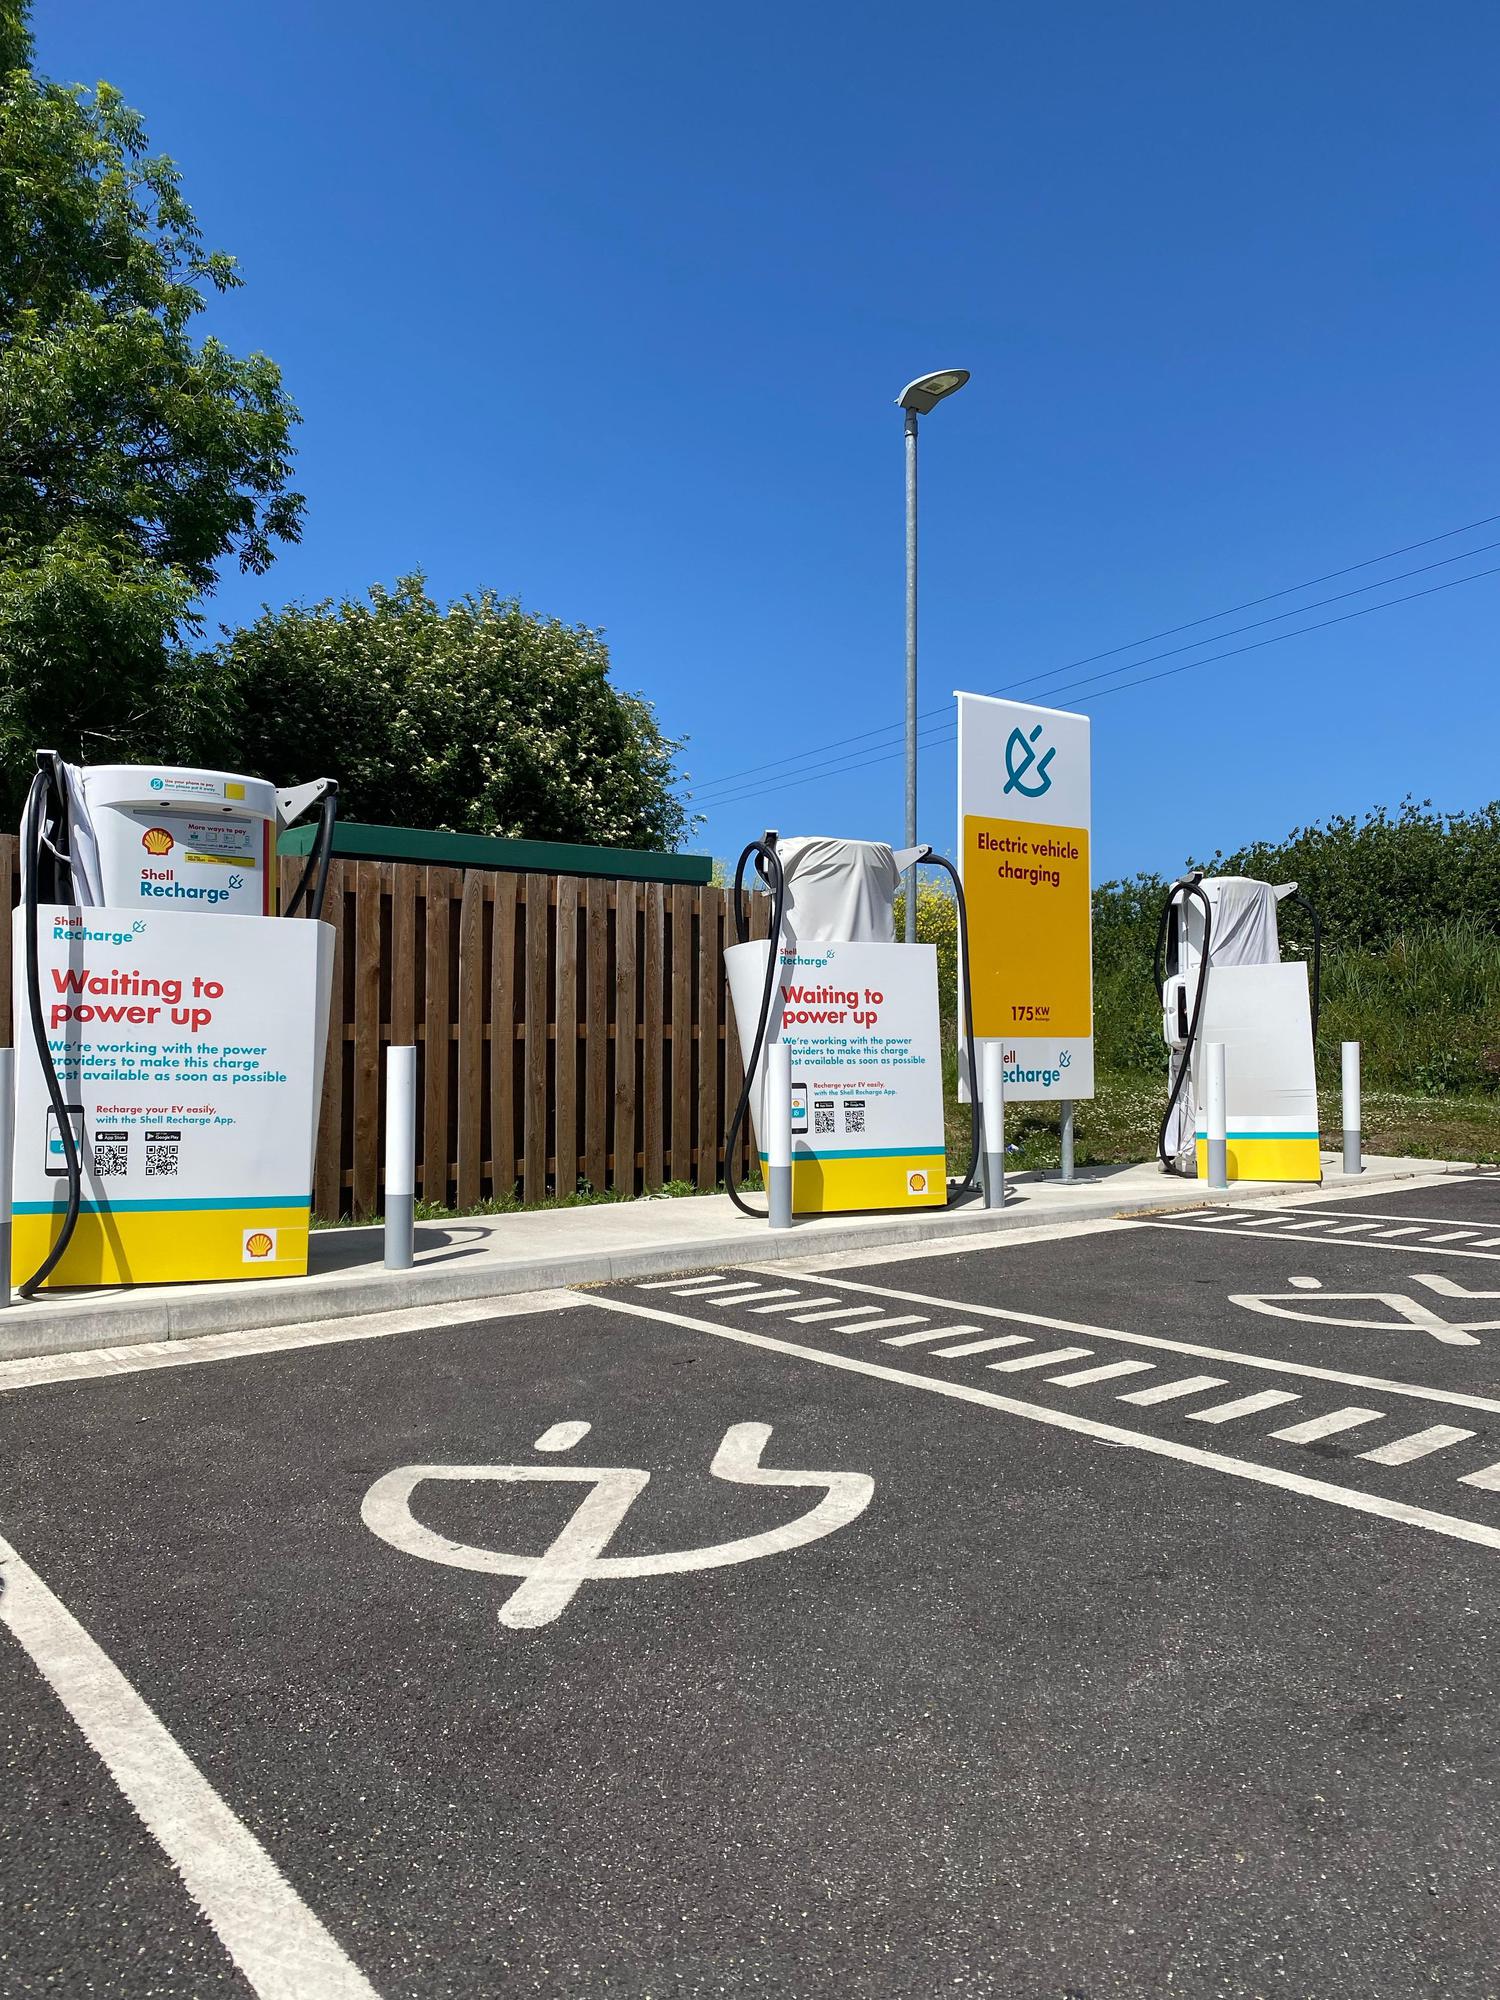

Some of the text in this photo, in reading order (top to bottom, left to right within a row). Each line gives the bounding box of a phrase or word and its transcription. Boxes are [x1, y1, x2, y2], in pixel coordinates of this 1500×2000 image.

[978, 832, 1078, 859] Electric vehicle
[142, 869, 173, 880] Shell
[998, 861, 1060, 887] charging
[141, 882, 229, 903] Recharge
[54, 917, 83, 926] Shell
[53, 927, 133, 945] Recharge
[780, 956, 827, 967] Recharge
[51, 969, 224, 1004] Waiting to
[781, 985, 883, 1009] Waiting to
[50, 1004, 212, 1032] power up
[783, 1010, 878, 1029] power up
[1012, 1006, 1033, 1021] 175
[1036, 1006, 1049, 1015] KW
[811, 1036, 847, 1046] working
[48, 1041, 266, 1057] We're working with the power
[881, 1046, 908, 1056] charge
[1004, 1050, 1015, 1063] ell
[122, 1057, 135, 1066] to
[140, 1056, 179, 1067] make
[184, 1057, 208, 1068] this
[213, 1057, 259, 1071] charge
[893, 1056, 925, 1066] possible
[57, 1071, 78, 1080] ost
[83, 1069, 149, 1080] available
[233, 1071, 286, 1084] possible
[1003, 1064, 1060, 1086] echarge
[96, 1105, 142, 1115] Recharge
[187, 1106, 216, 1115] easily,
[167, 1116, 210, 1125] Recharge
[214, 1116, 236, 1125] App.
